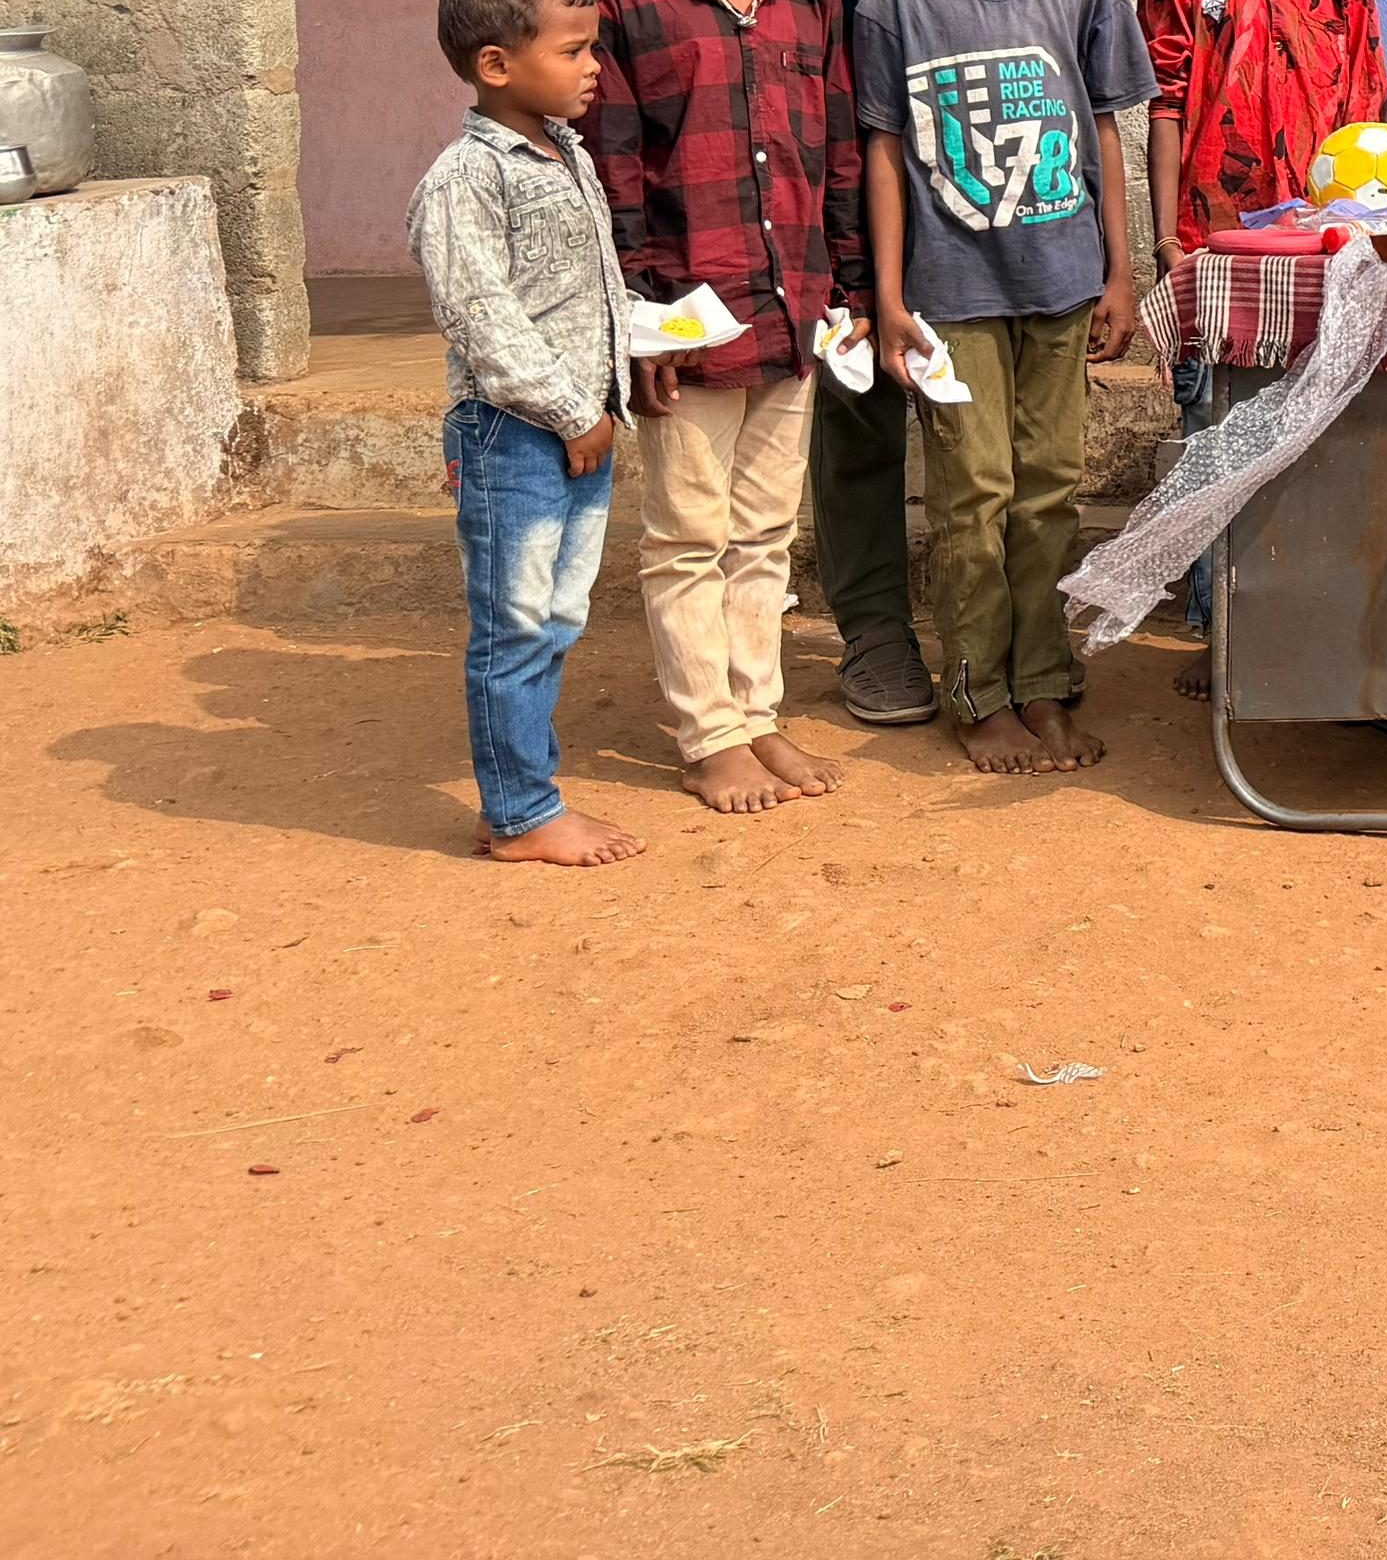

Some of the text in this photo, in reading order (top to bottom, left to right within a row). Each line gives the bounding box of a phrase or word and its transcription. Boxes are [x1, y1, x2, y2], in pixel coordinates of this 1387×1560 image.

[998, 60, 1045, 79] MAN
[1000, 80, 1044, 100] RIDE
[1002, 99, 1067, 120] RACING
[1016, 197, 1079, 217] On The Edge
